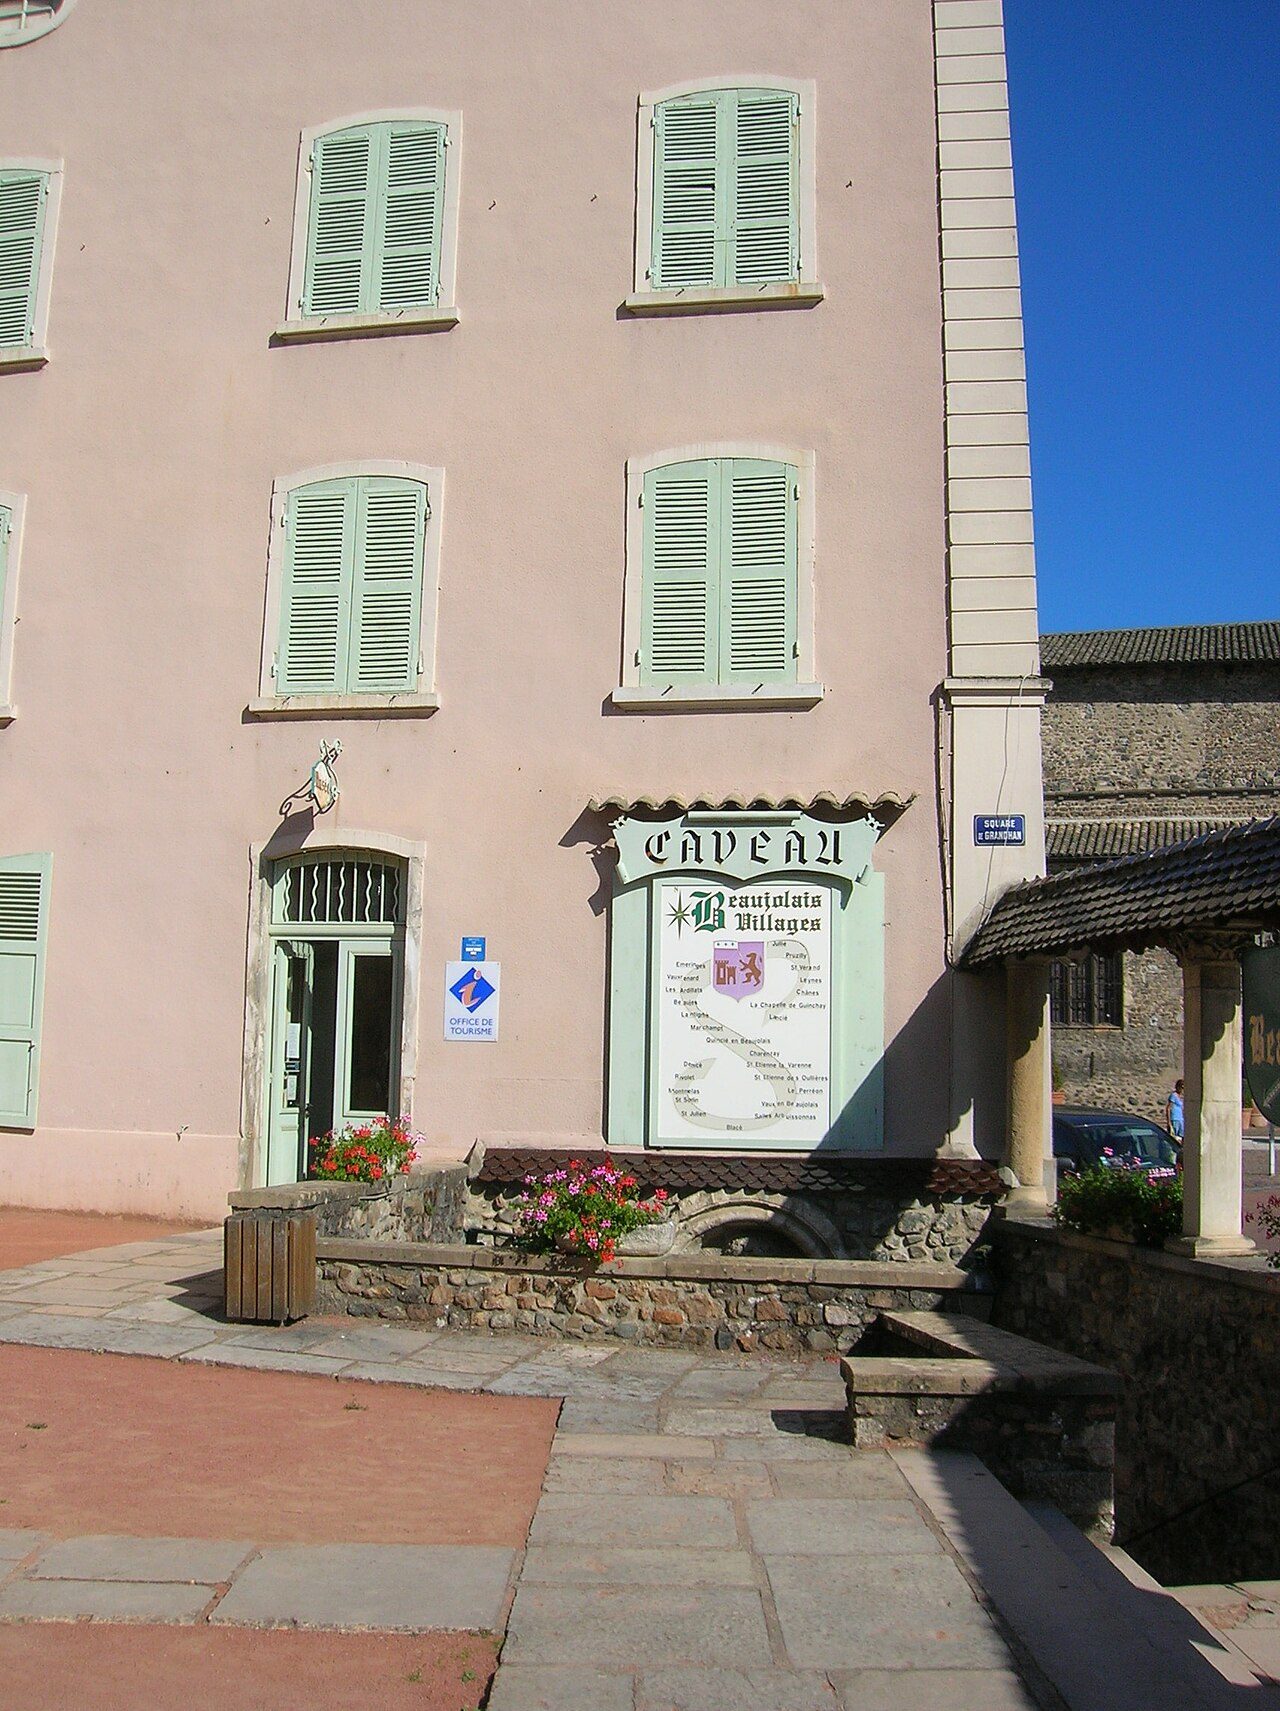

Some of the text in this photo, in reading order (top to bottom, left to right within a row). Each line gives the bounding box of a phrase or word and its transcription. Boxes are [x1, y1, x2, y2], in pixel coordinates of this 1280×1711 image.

[983, 819, 1016, 829] SQUARE
[984, 831, 1022, 840] GRANDHAN
[644, 829, 843, 866] CAVEAU
[689, 890, 823, 933] Beaujolais
[734, 912, 822, 935] Villages
[450, 1018, 493, 1026] OFFICE DE
[451, 1027, 492, 1035] TOURISME
